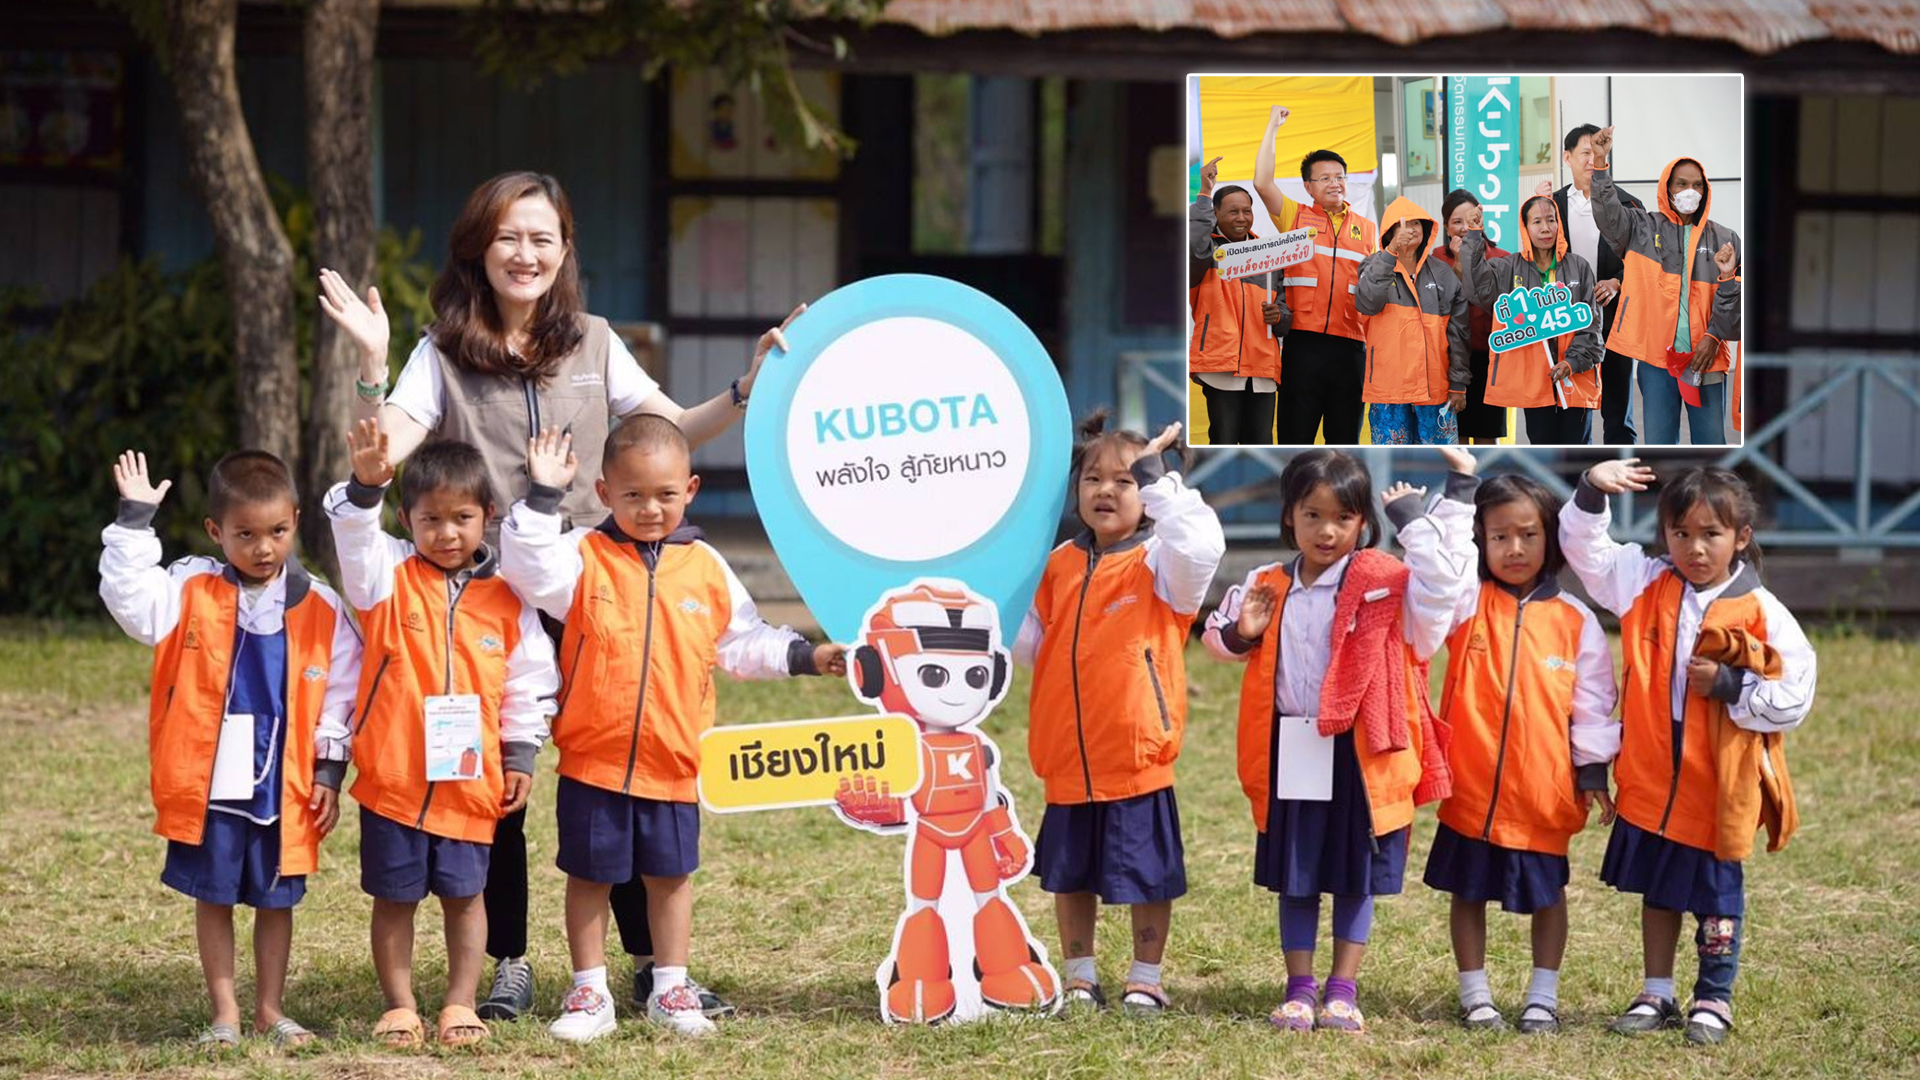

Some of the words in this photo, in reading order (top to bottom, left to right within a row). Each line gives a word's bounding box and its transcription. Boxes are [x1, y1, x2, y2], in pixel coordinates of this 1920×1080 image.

[1226, 231, 1307, 257] เปิดประสบการณ์ครั้งใหญ่
[1500, 299, 1510, 318] ที่
[1513, 291, 1528, 312] 1
[1533, 288, 1566, 308] ในใจ
[1494, 327, 1536, 346] ตลอด
[1540, 306, 1572, 331] 45
[1574, 307, 1588, 322] ปี
[814, 393, 999, 444] KUBOTA
[815, 456, 891, 488] พลังใจ
[900, 448, 1007, 484] สู้ภัยหนาว
[728, 729, 886, 782] เชียงใหม่
